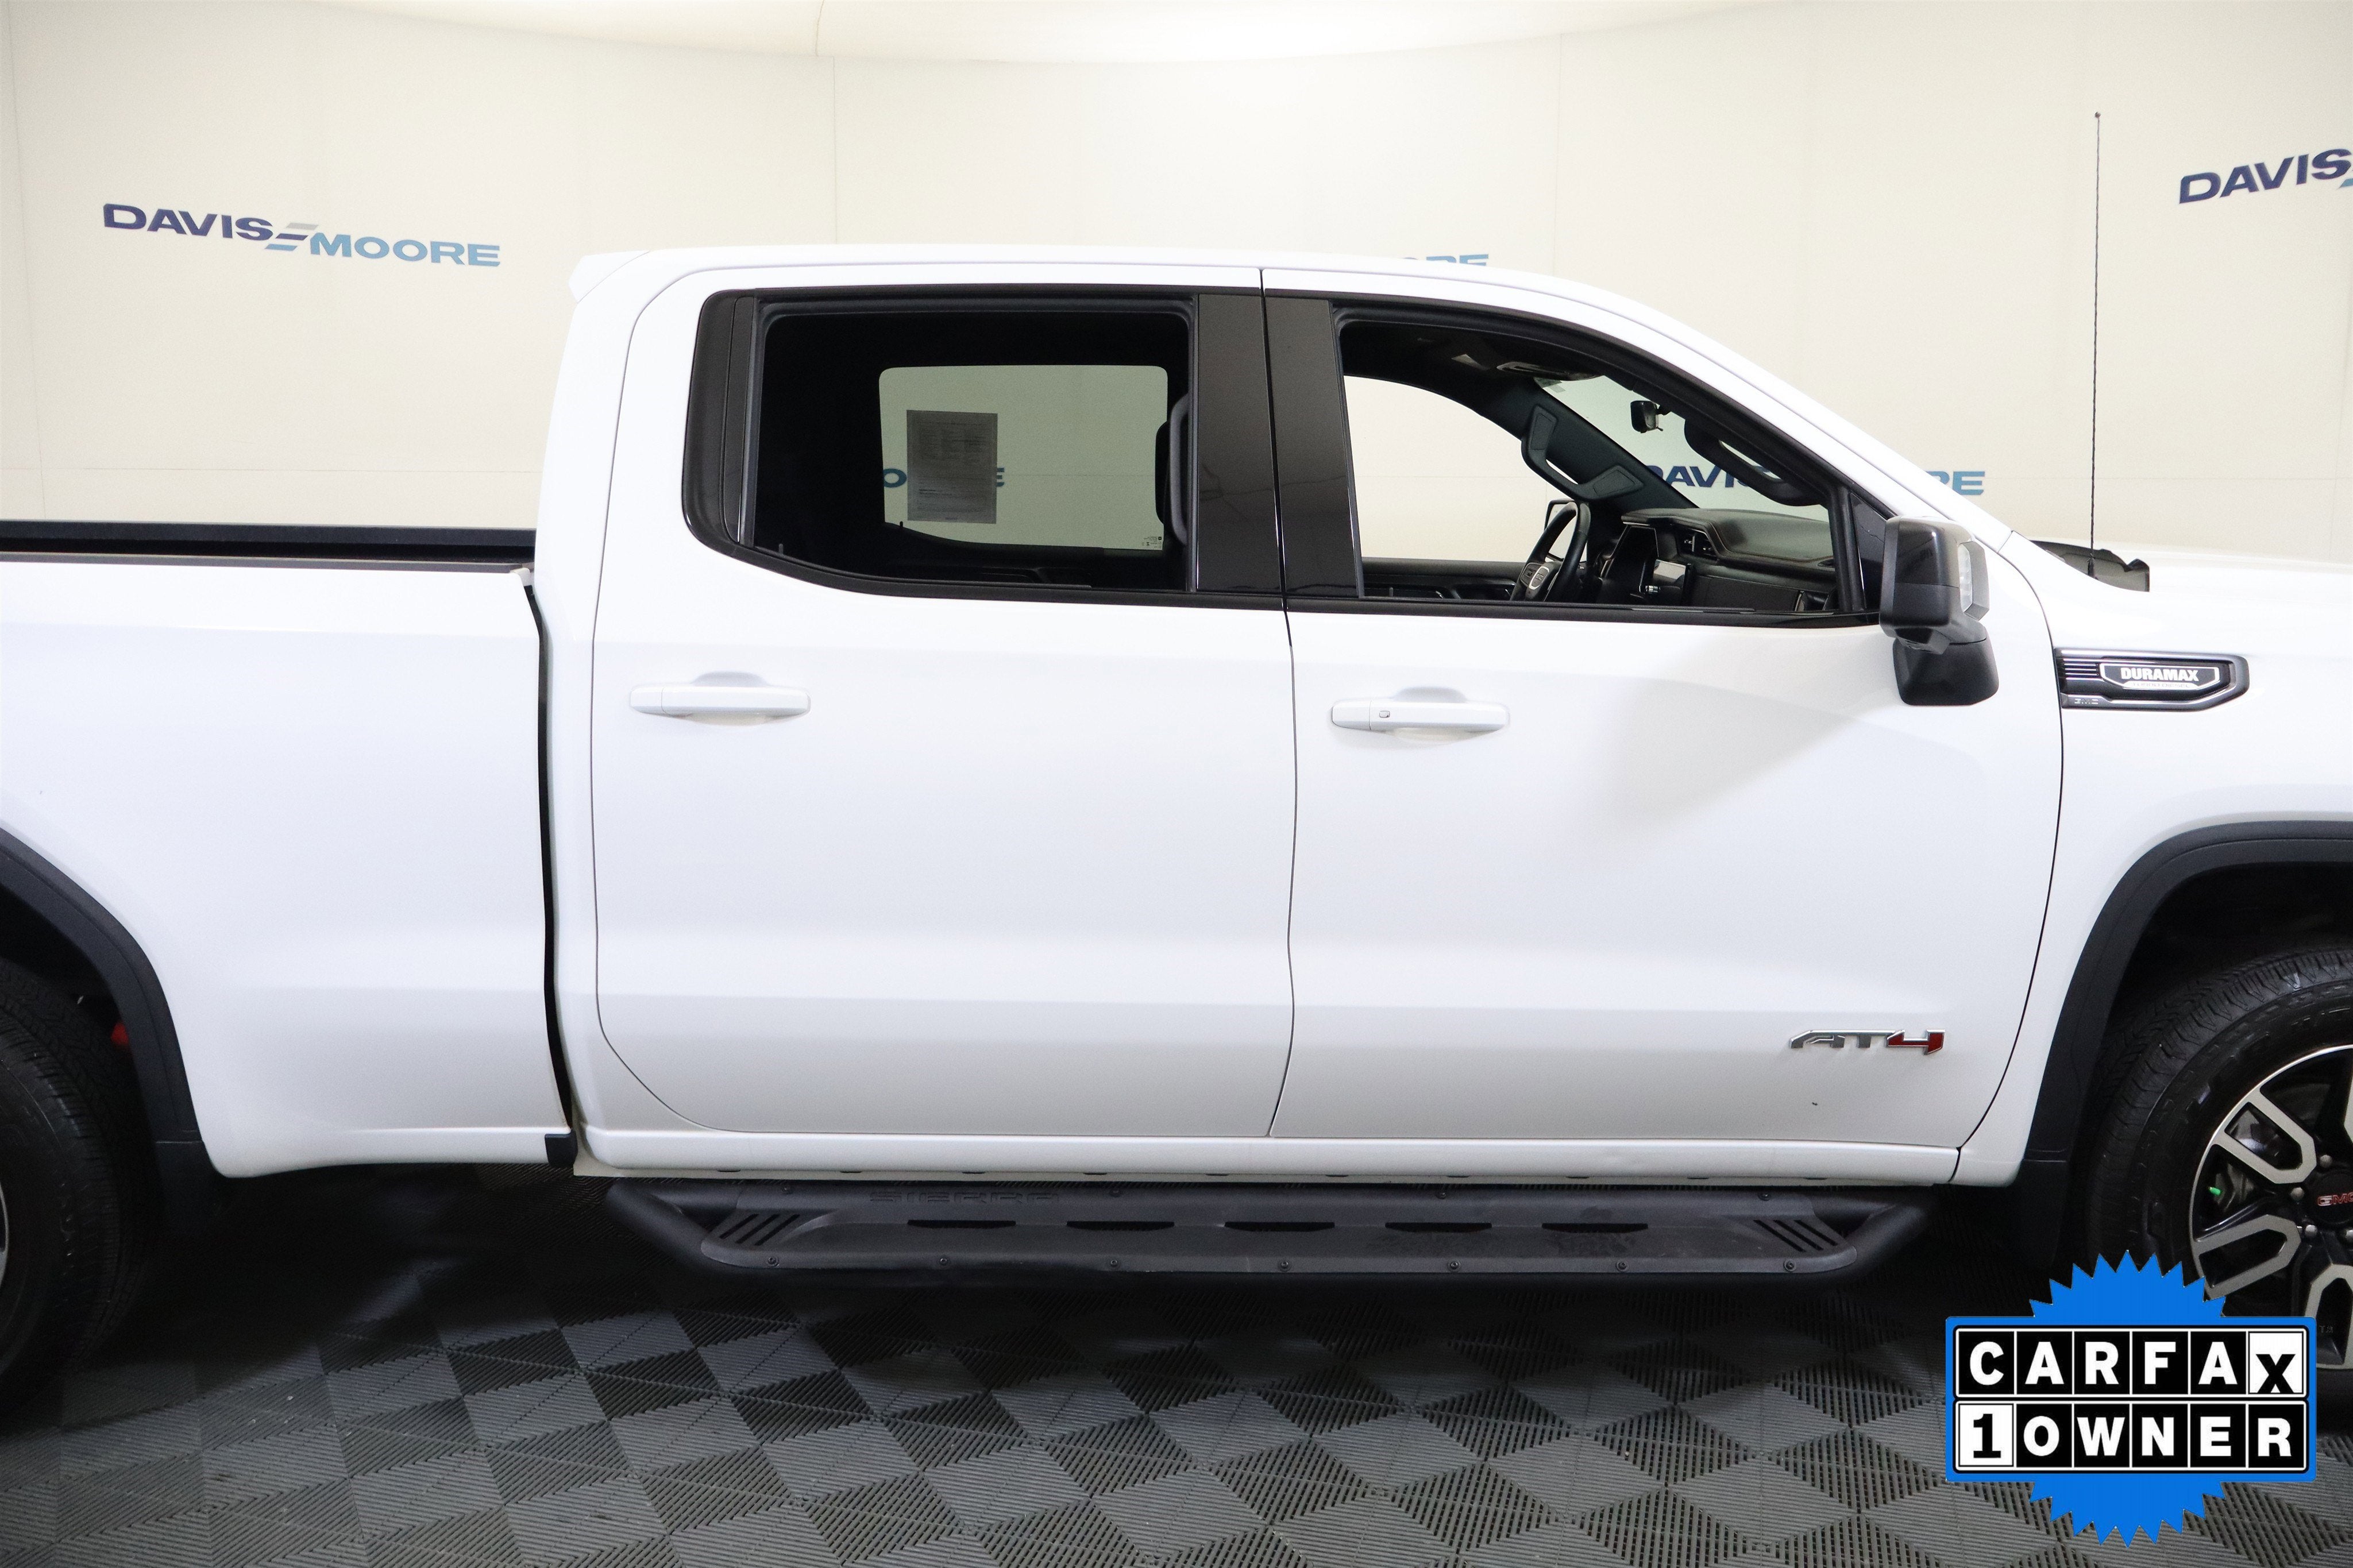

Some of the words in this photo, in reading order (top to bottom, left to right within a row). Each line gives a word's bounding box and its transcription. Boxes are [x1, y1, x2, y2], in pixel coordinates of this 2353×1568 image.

[2179, 148, 2352, 204] DAVIS
[102, 203, 274, 241] DAVIS
[310, 232, 500, 267] MOORE
[2120, 667, 2199, 682] DURAMAX
[1789, 1029, 1946, 1055] AT4
